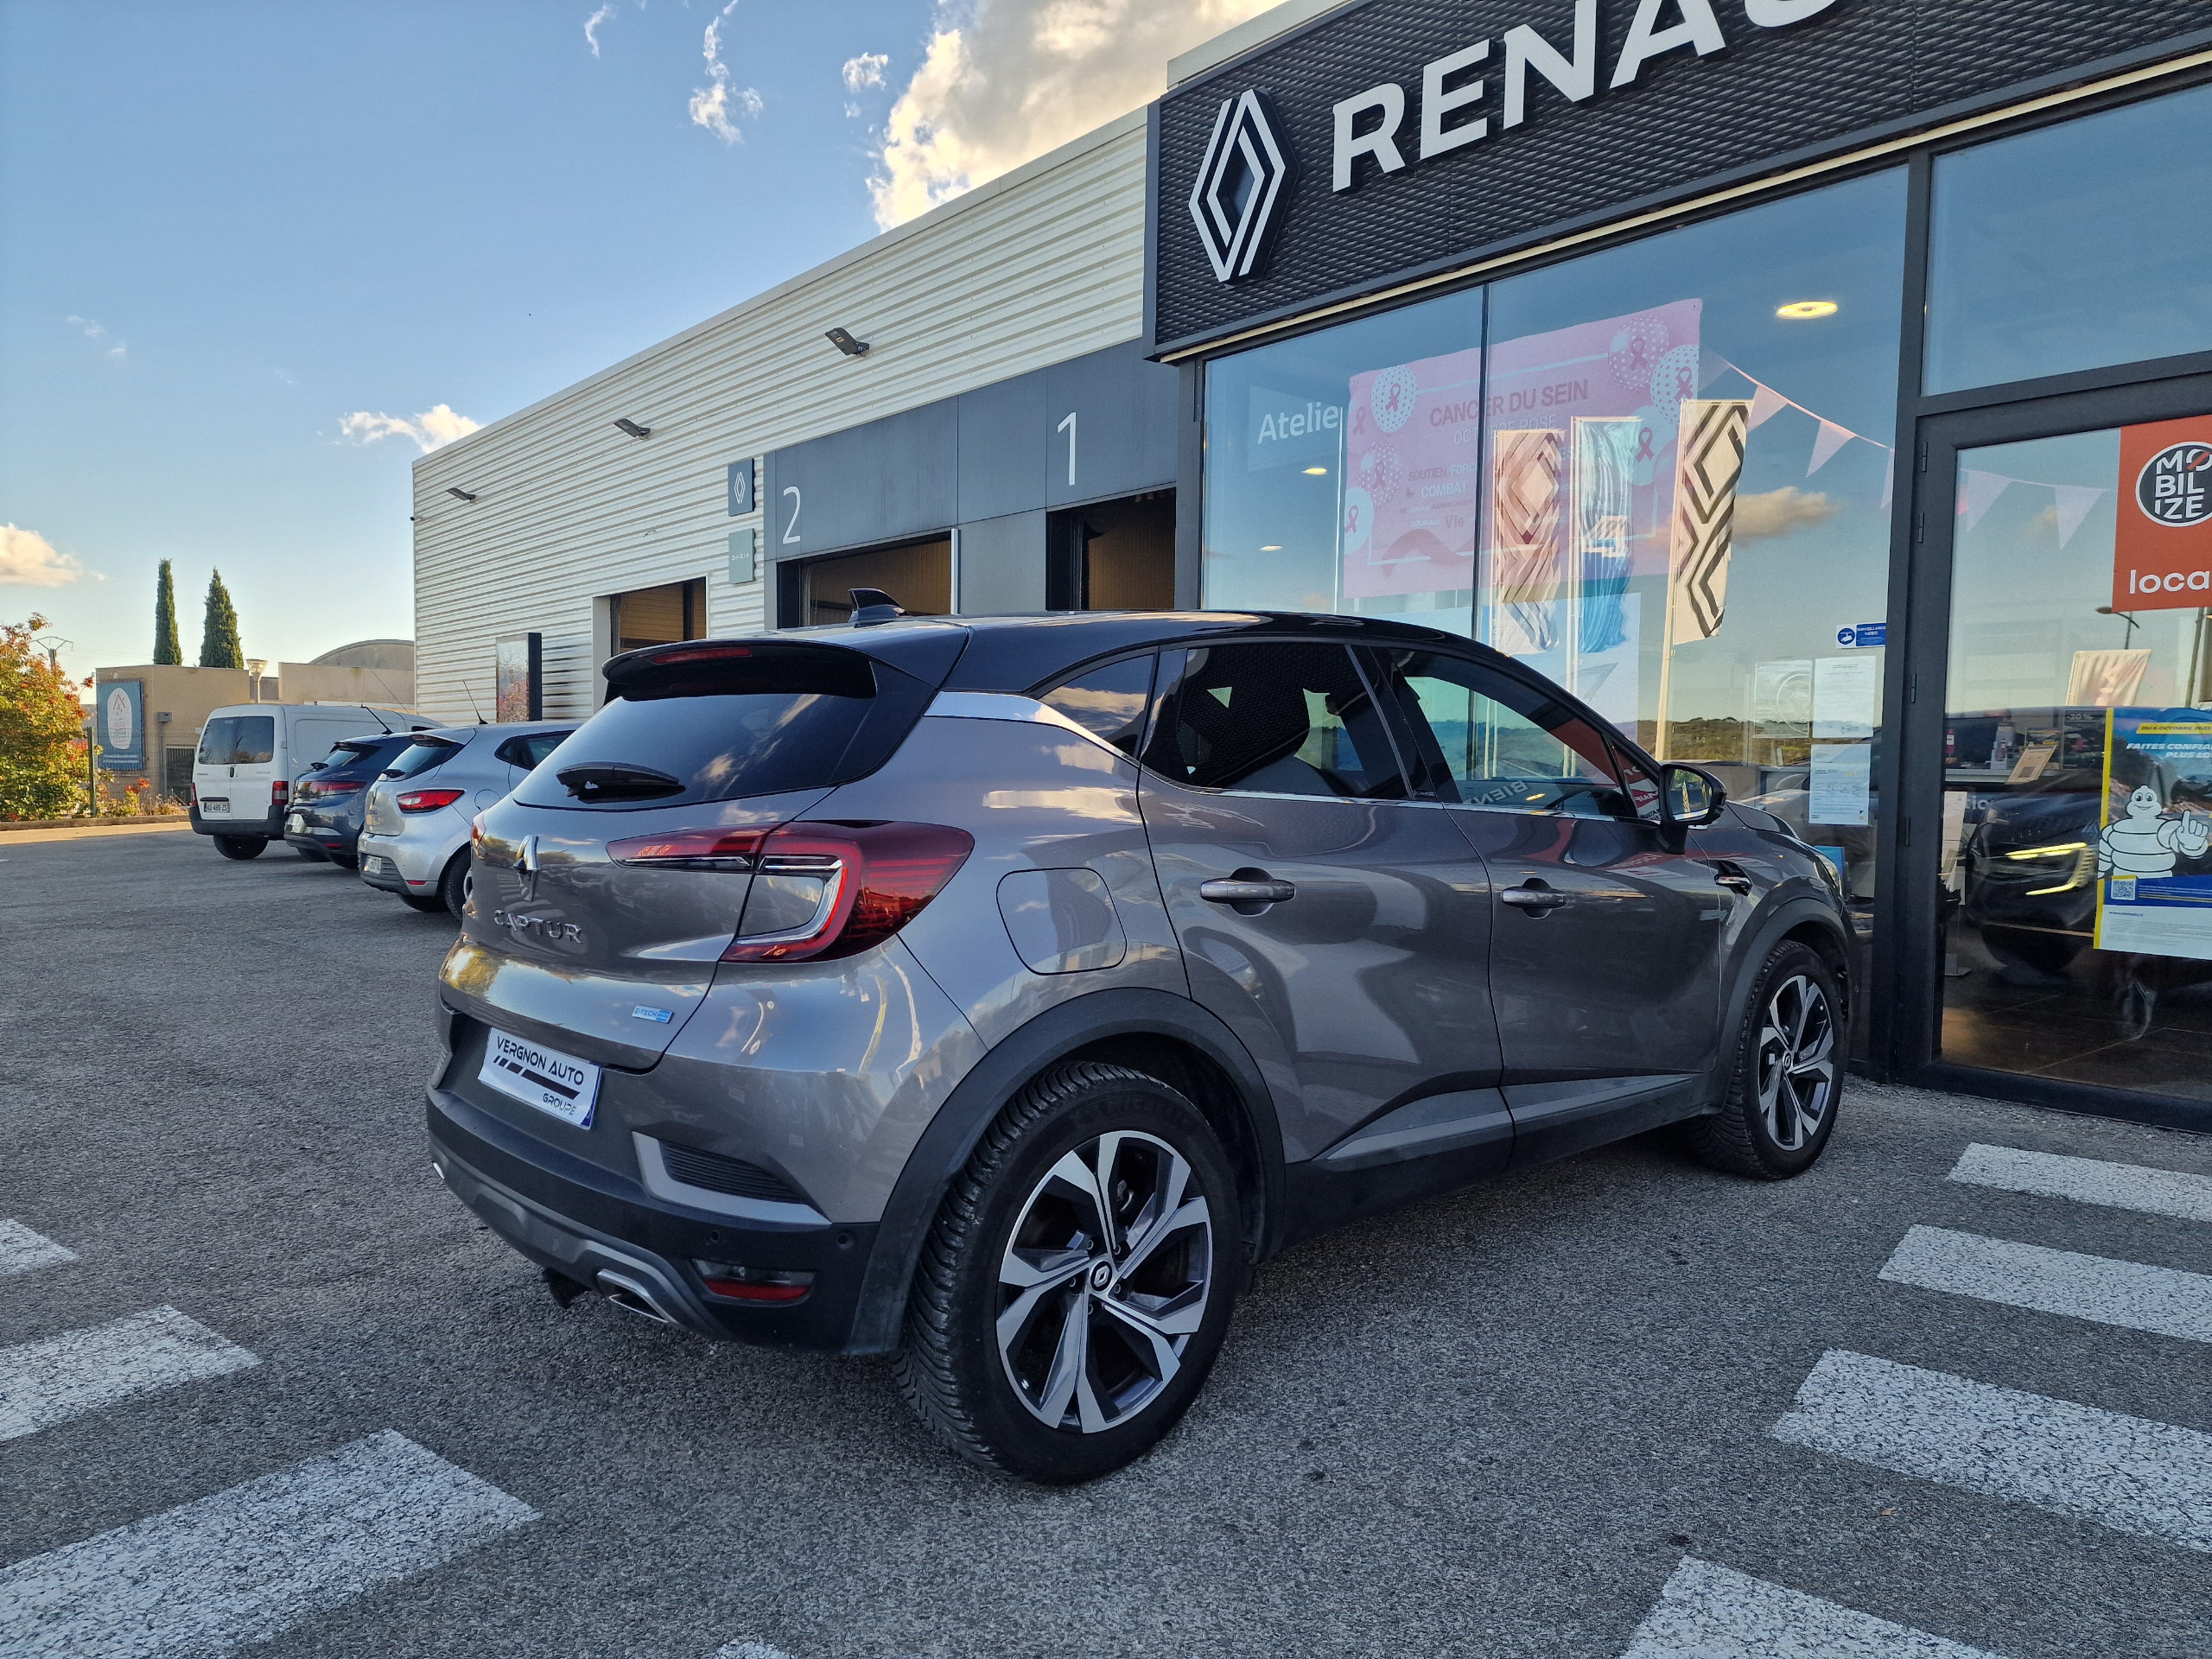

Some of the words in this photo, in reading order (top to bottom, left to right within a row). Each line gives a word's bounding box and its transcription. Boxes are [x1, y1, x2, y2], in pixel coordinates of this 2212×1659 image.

[1332, 0, 1840, 193] RENA
[1510, 388, 1536, 413] DU
[1541, 378, 1588, 407] SEIN
[1520, 414, 1557, 430] ROSE
[1057, 411, 1077, 486] 1
[1408, 467, 1447, 481] SOUTIEN
[2155, 472, 2205, 498] BIL
[1421, 480, 1469, 499] COMBAT
[782, 486, 801, 545] 2
[2154, 495, 2203, 519] IZE
[1445, 515, 1465, 528] Vie
[2129, 569, 2210, 594] loca
[493, 909, 582, 944] CAPTUR
[634, 1008, 658, 1017] E-TECH
[496, 1035, 547, 1070] VERGNON
[548, 1060, 584, 1086] AUTO
[543, 1092, 577, 1116] GROUPE
